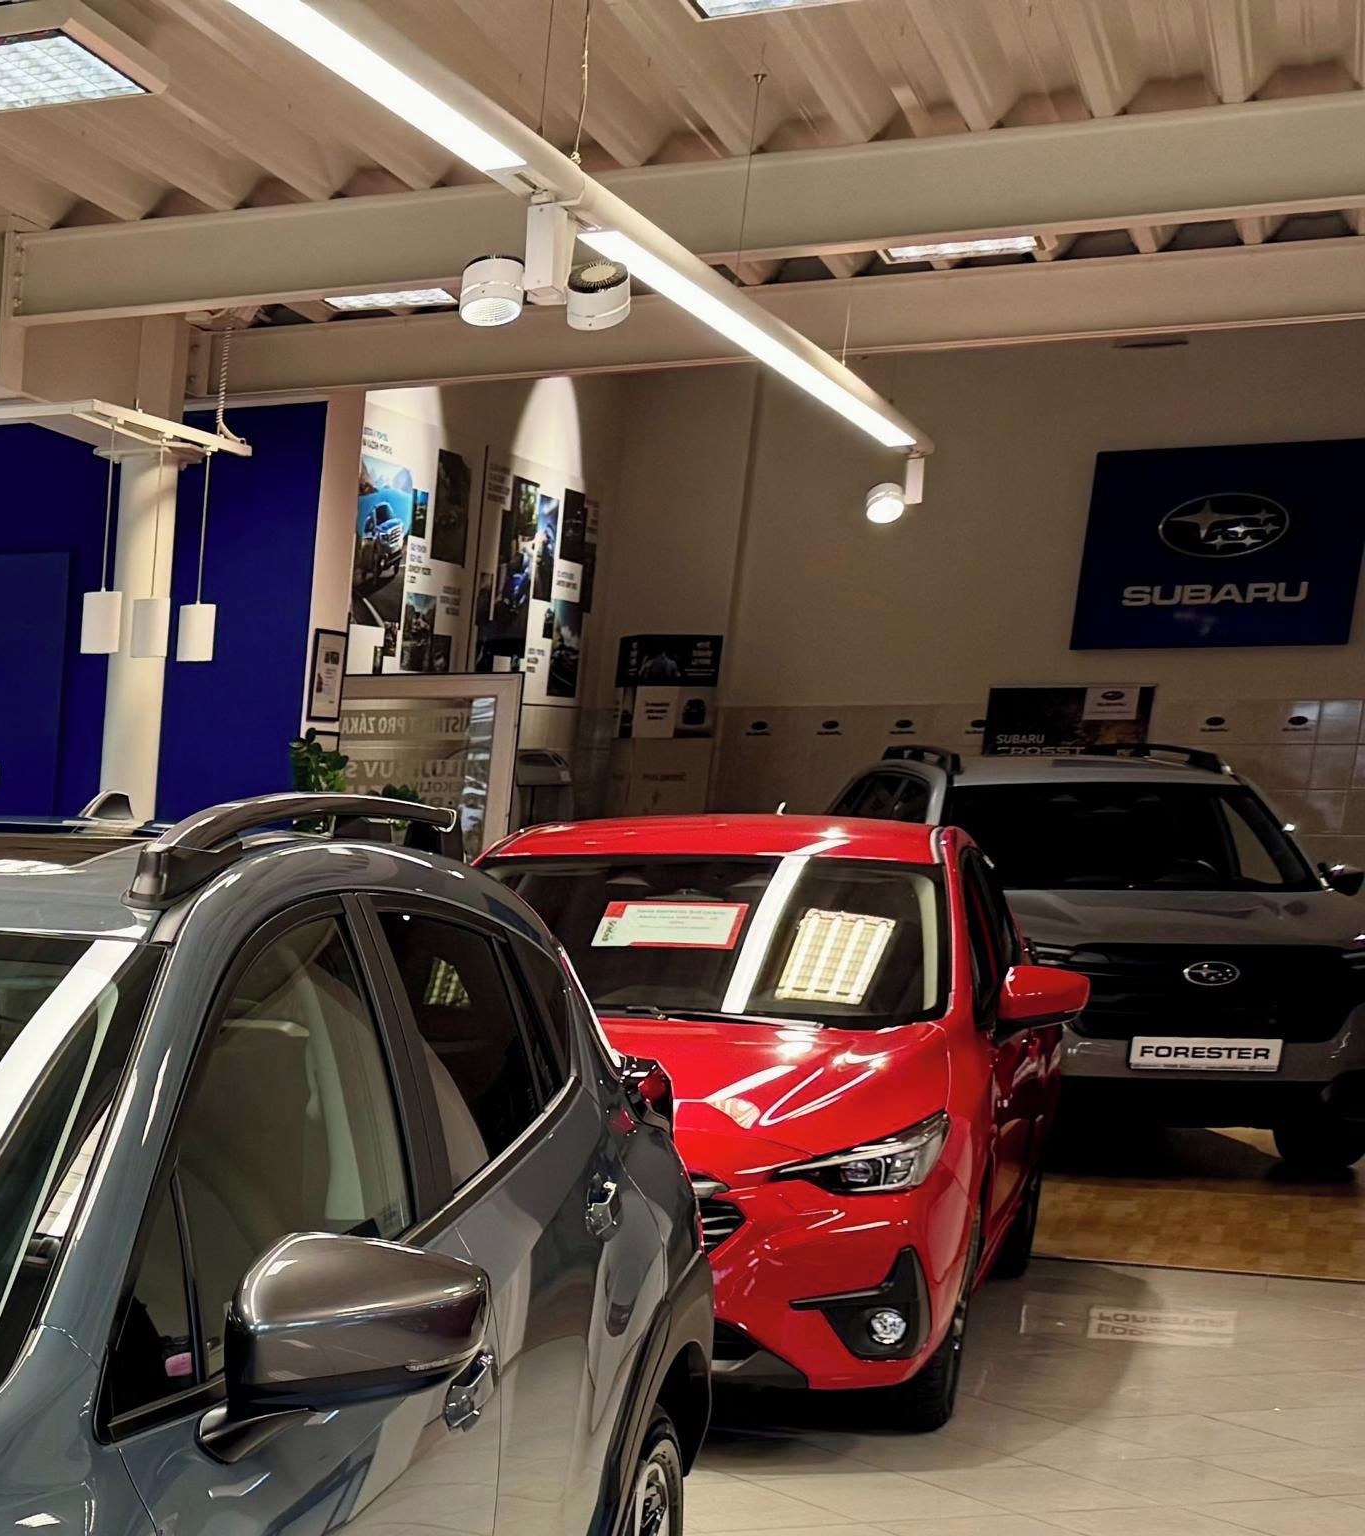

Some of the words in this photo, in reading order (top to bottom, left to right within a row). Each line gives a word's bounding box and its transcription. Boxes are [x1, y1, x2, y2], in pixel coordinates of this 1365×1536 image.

[1121, 581, 1310, 607] SUBARU
[996, 733, 1046, 745] SUBARU
[1139, 1045, 1271, 1060] FORESTER
